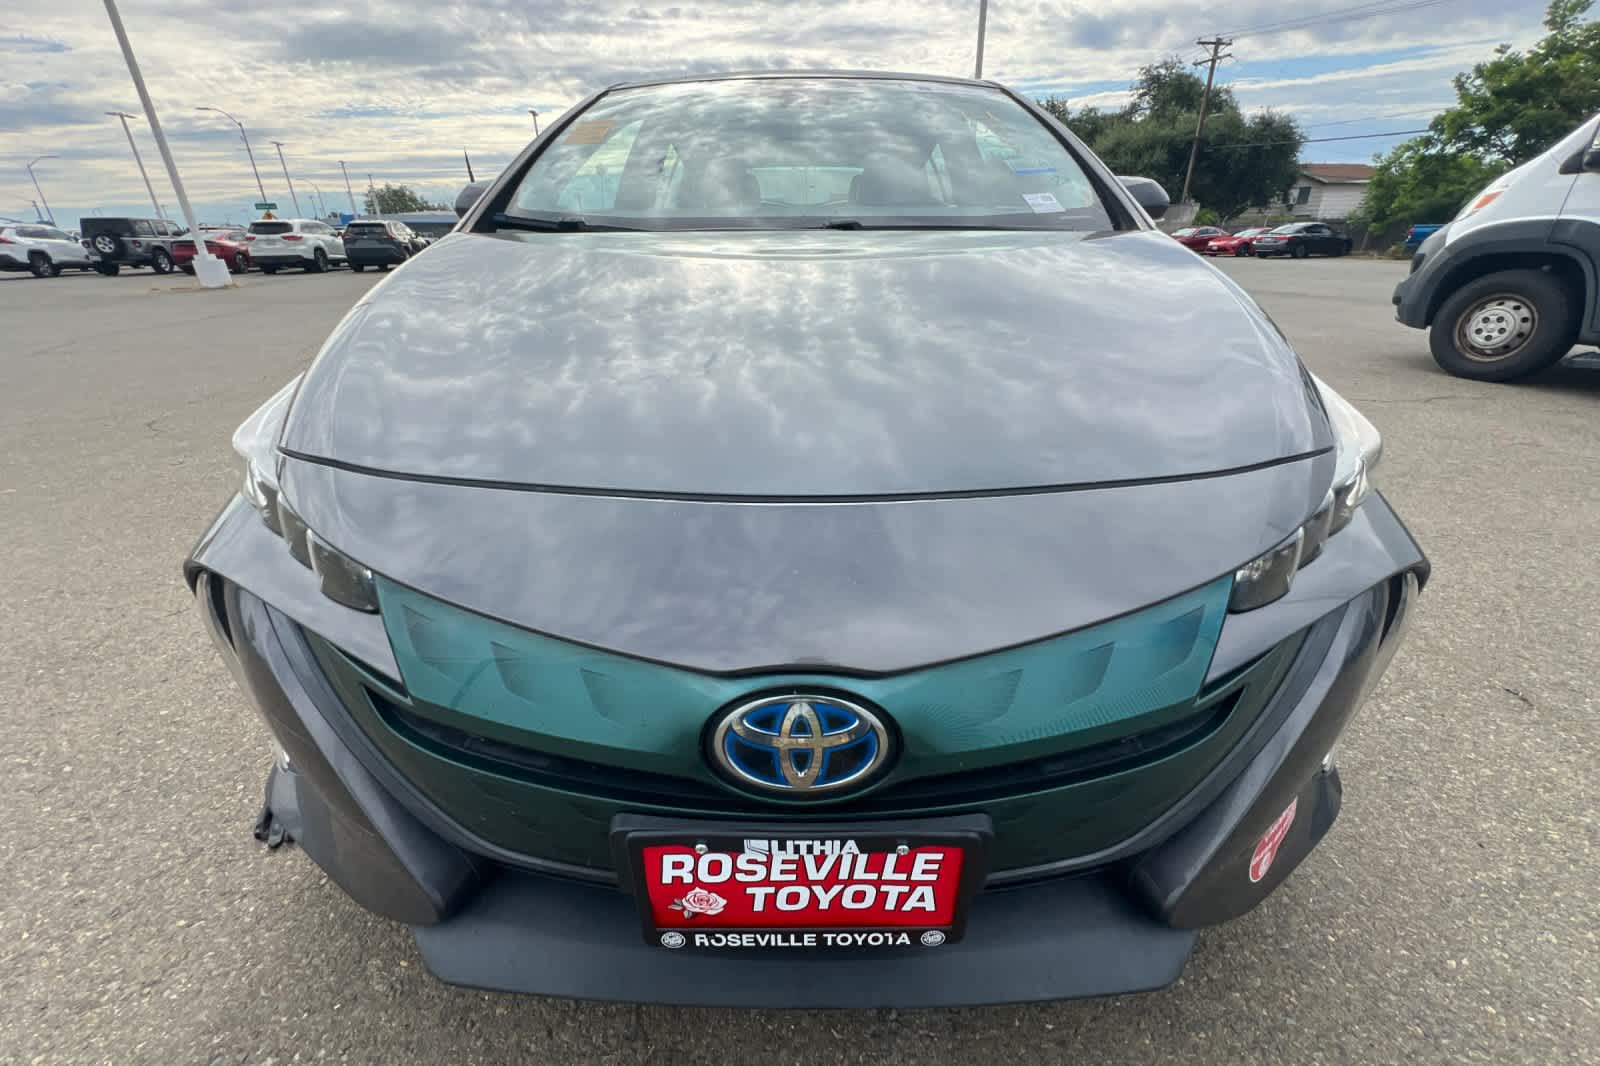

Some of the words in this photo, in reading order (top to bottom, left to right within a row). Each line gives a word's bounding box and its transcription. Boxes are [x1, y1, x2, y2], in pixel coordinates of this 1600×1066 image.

[770, 839, 861, 856] LITHIA
[661, 852, 945, 884] ROSEVILLE
[745, 884, 937, 912] TOYOTA
[694, 933, 817, 947] ROSEVILLE
[822, 932, 911, 946] TOYOTA
